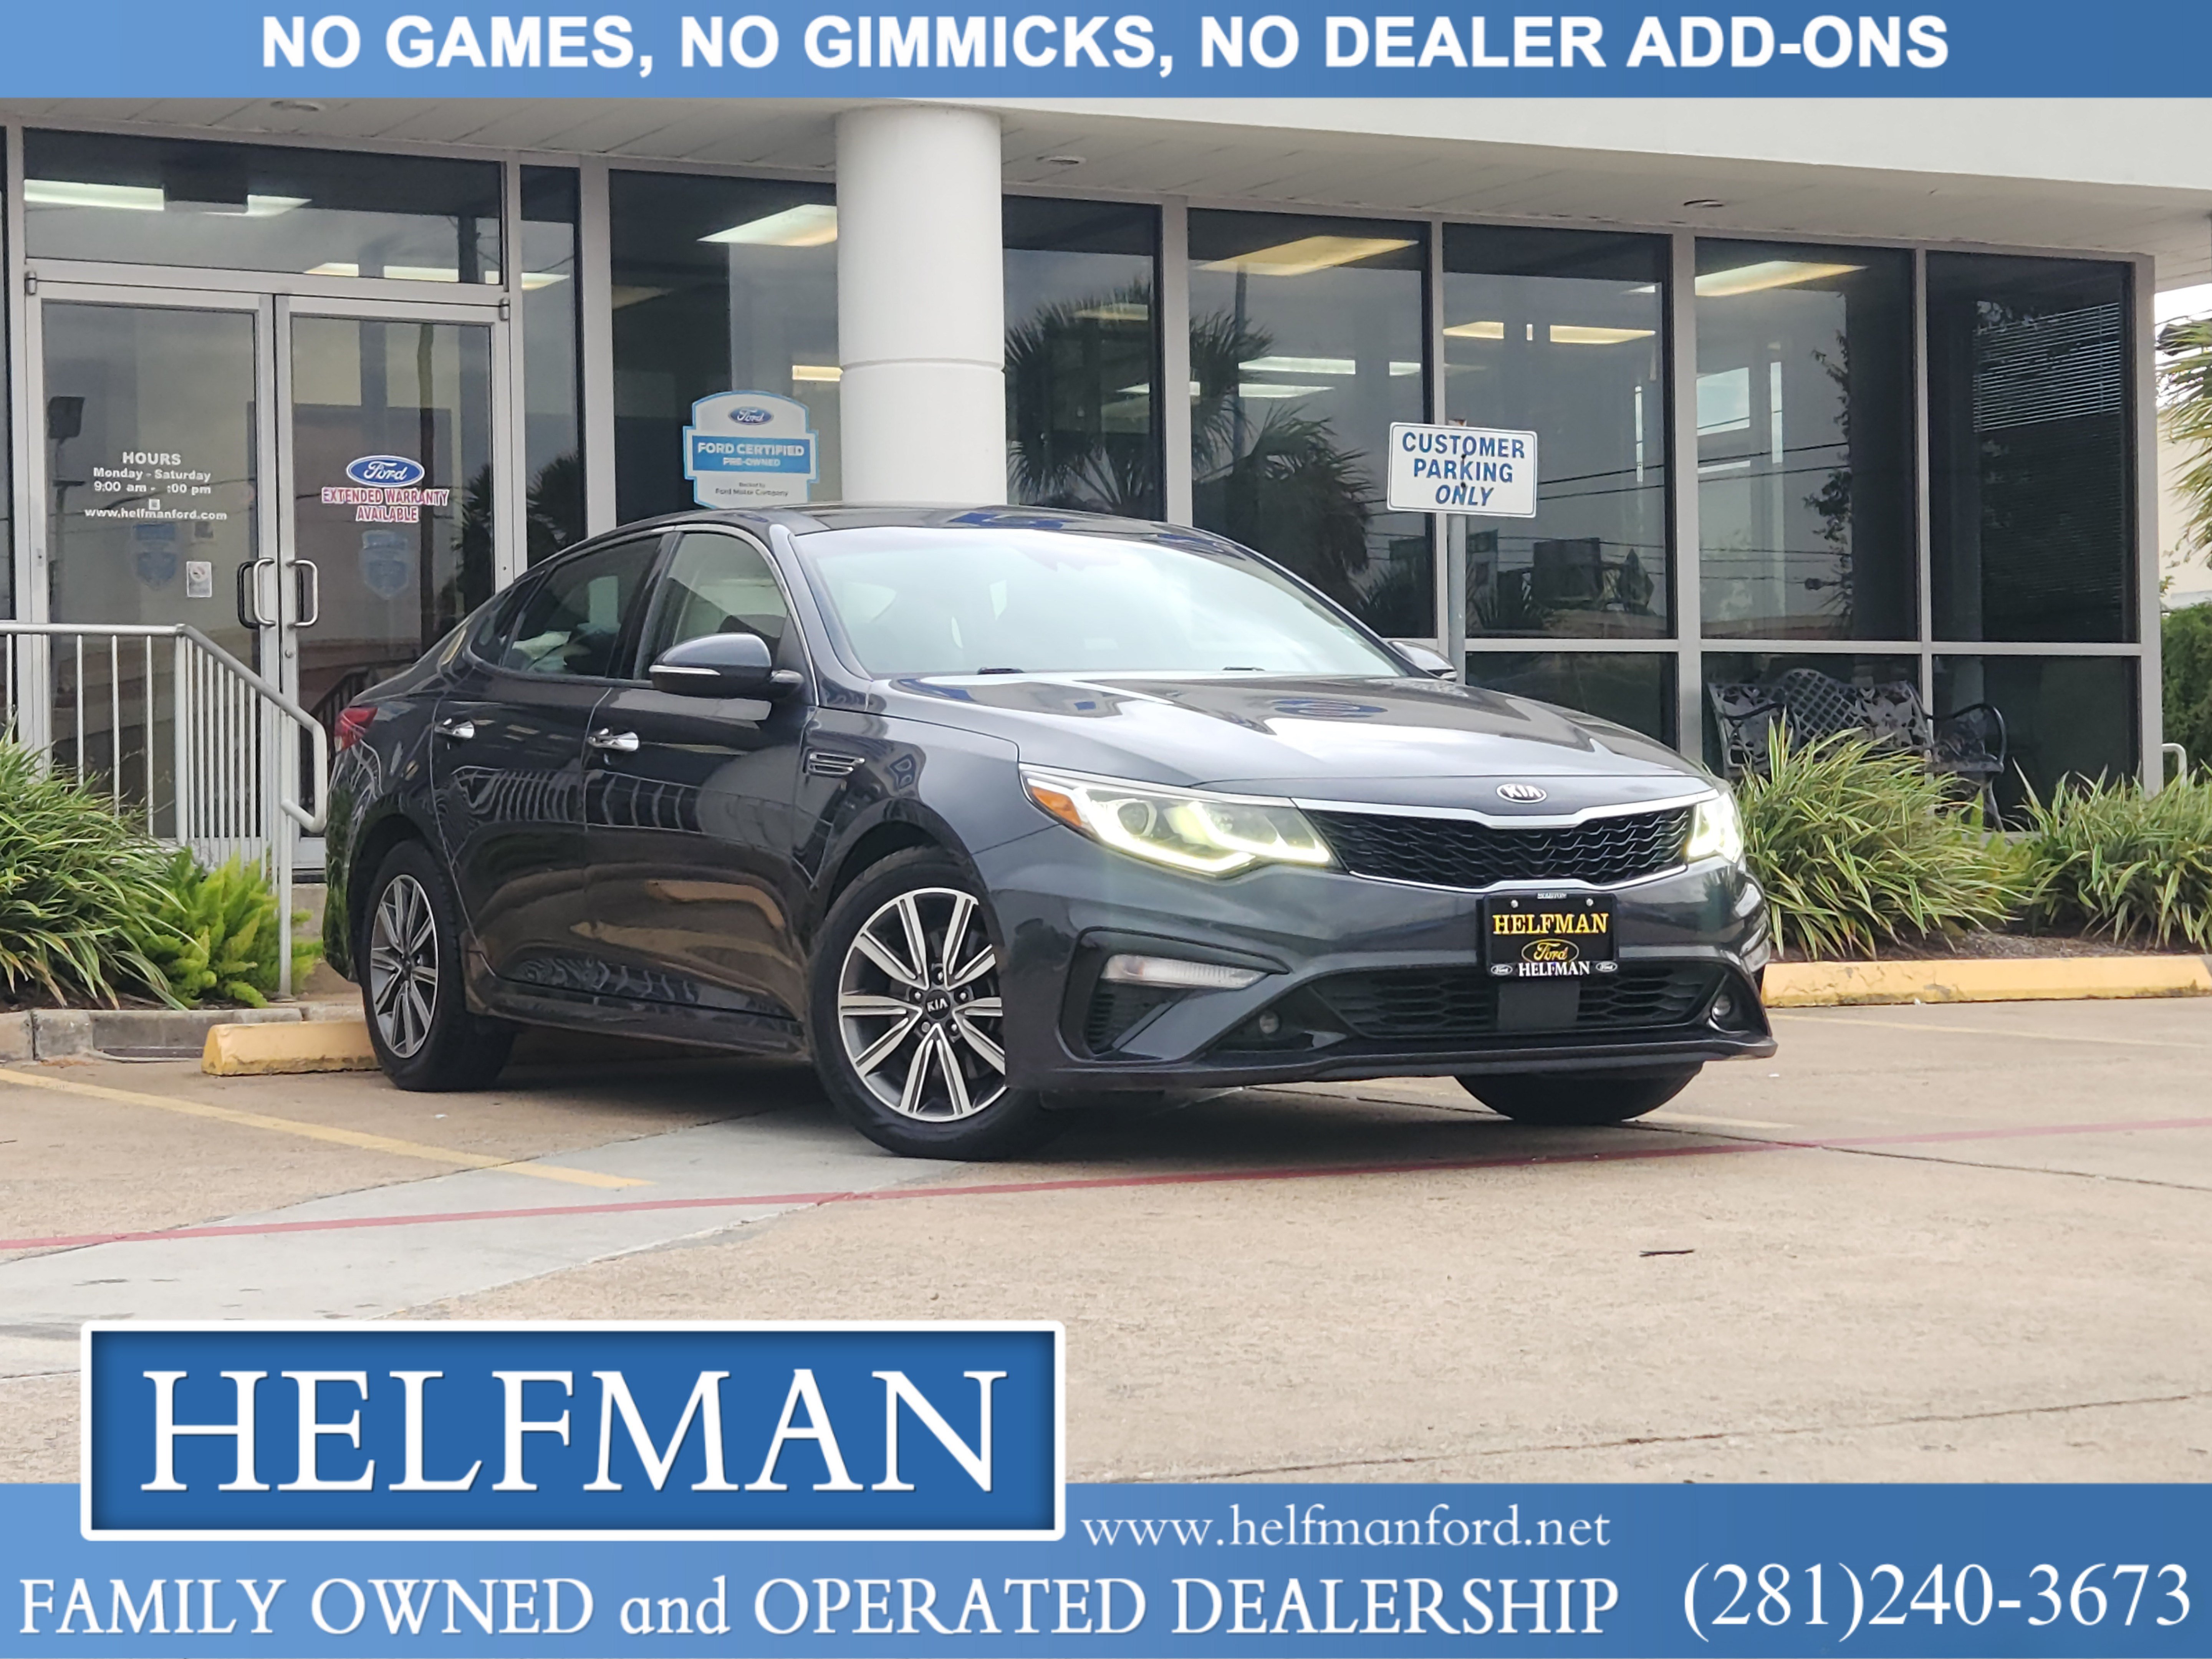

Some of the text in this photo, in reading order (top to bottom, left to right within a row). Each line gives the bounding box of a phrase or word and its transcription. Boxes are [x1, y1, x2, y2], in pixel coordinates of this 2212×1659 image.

[737, 408, 765, 422] Ford
[697, 442, 805, 457] FORD CERTIFIED
[1402, 432, 1525, 459] CUSTOMER
[123, 452, 181, 465] HOURS
[723, 457, 781, 467] PRE-OWNED
[93, 467, 143, 480] Monday
[154, 469, 211, 483] Saturday
[363, 461, 408, 480] Ford
[1414, 458, 1513, 483] PARKING
[93, 480, 121, 492] 9:00
[126, 484, 147, 492] am
[192, 486, 211, 496] pm
[1435, 485, 1494, 506] ONLY
[323, 488, 449, 505] EXTENDED WARRANTY
[84, 508, 228, 520] www.helfmanford.com
[357, 506, 418, 522] AVAILABLE
[1503, 784, 1542, 799] KIA
[1492, 912, 1609, 935] HELFMAN
[1533, 942, 1569, 961] Ford
[1518, 961, 1591, 977] HELFMAN
[926, 998, 949, 1012] KIA
